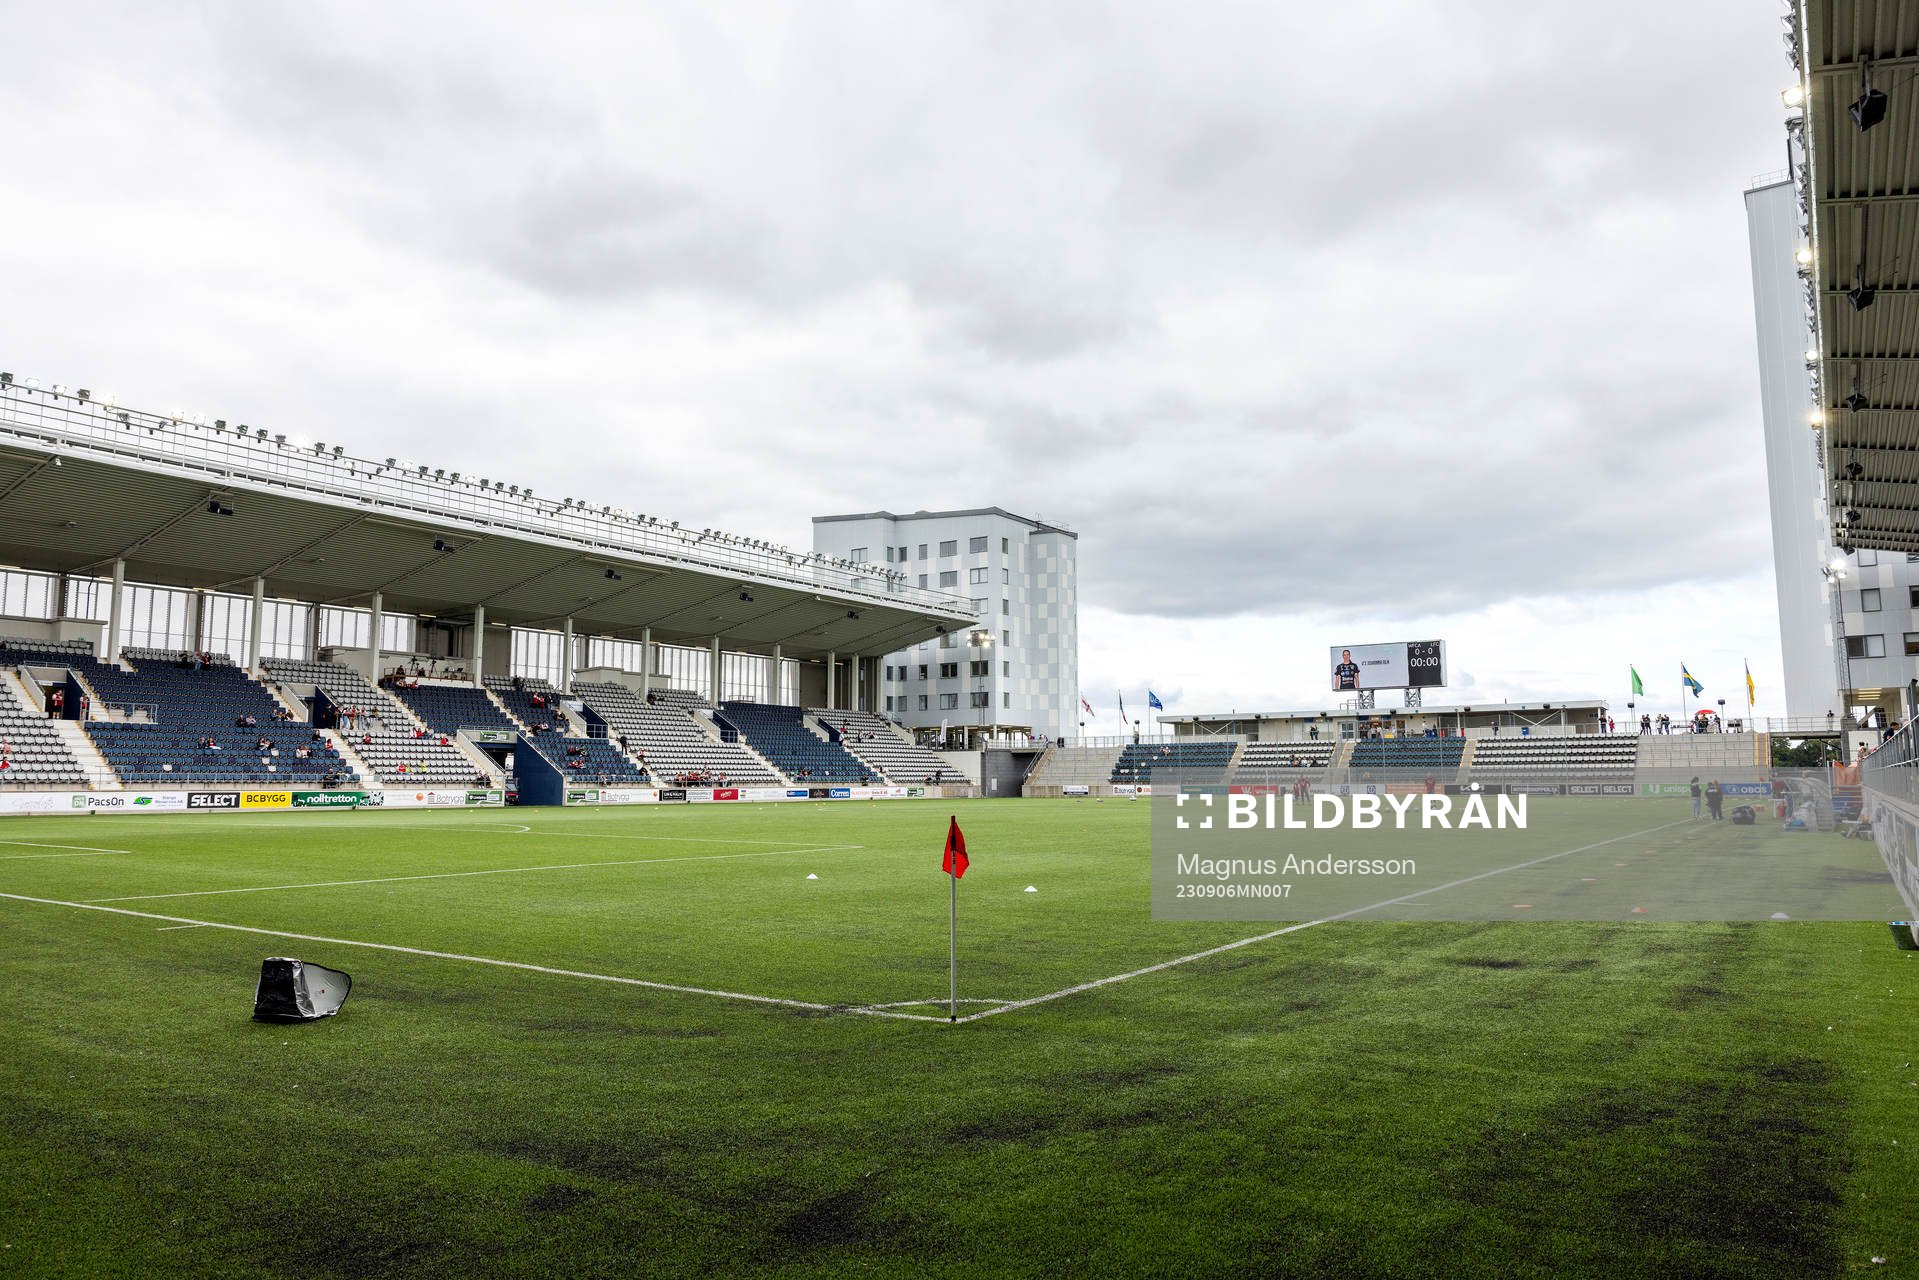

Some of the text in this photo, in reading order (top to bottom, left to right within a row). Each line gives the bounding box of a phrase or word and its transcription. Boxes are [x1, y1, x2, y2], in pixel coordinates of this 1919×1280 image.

[1427, 647, 1433, 655] 0
[1410, 657, 1438, 667] 00:00
[1603, 785, 1632, 793] SELECT
[1740, 786, 1767, 794] OBOS
[88, 796, 125, 807] PacsOn
[191, 794, 237, 806] SELECT
[246, 794, 286, 803] BCBYGG
[306, 793, 357, 803] nolltretton
